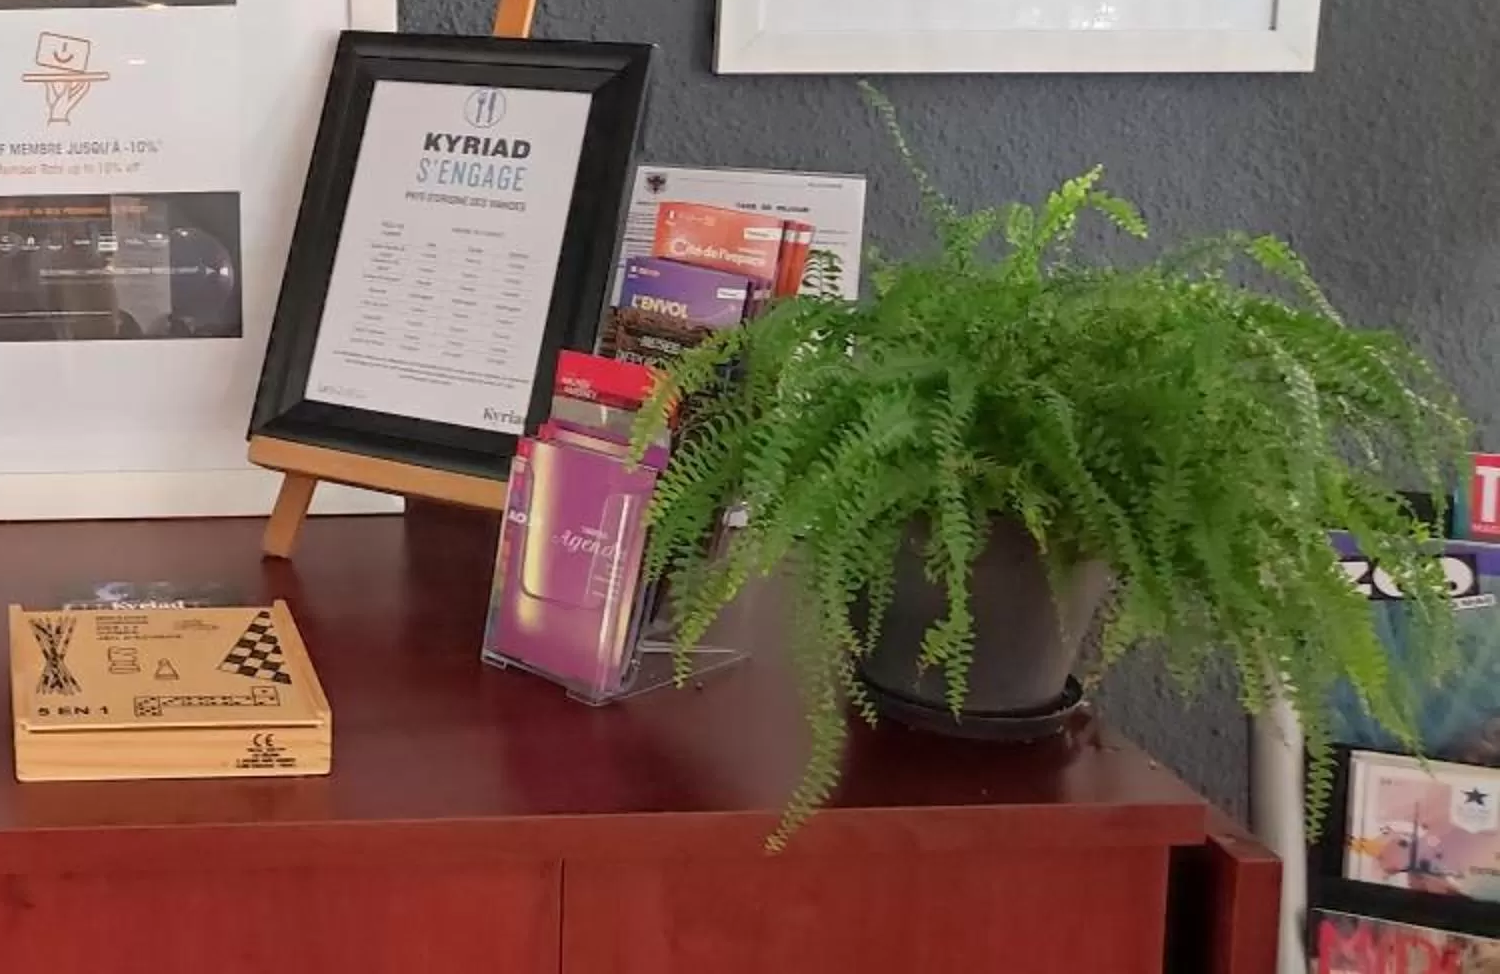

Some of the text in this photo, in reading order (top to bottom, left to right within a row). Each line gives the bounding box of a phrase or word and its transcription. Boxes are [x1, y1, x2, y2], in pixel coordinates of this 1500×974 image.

[8, 142, 63, 156] MEMBRE
[423, 132, 532, 160] KYRIAD
[416, 157, 528, 192] S'ENGAGE
[484, 406, 525, 426] Kyria
[38, 706, 51, 718] 5
[59, 705, 92, 717] EN
[253, 733, 274, 747] CE
